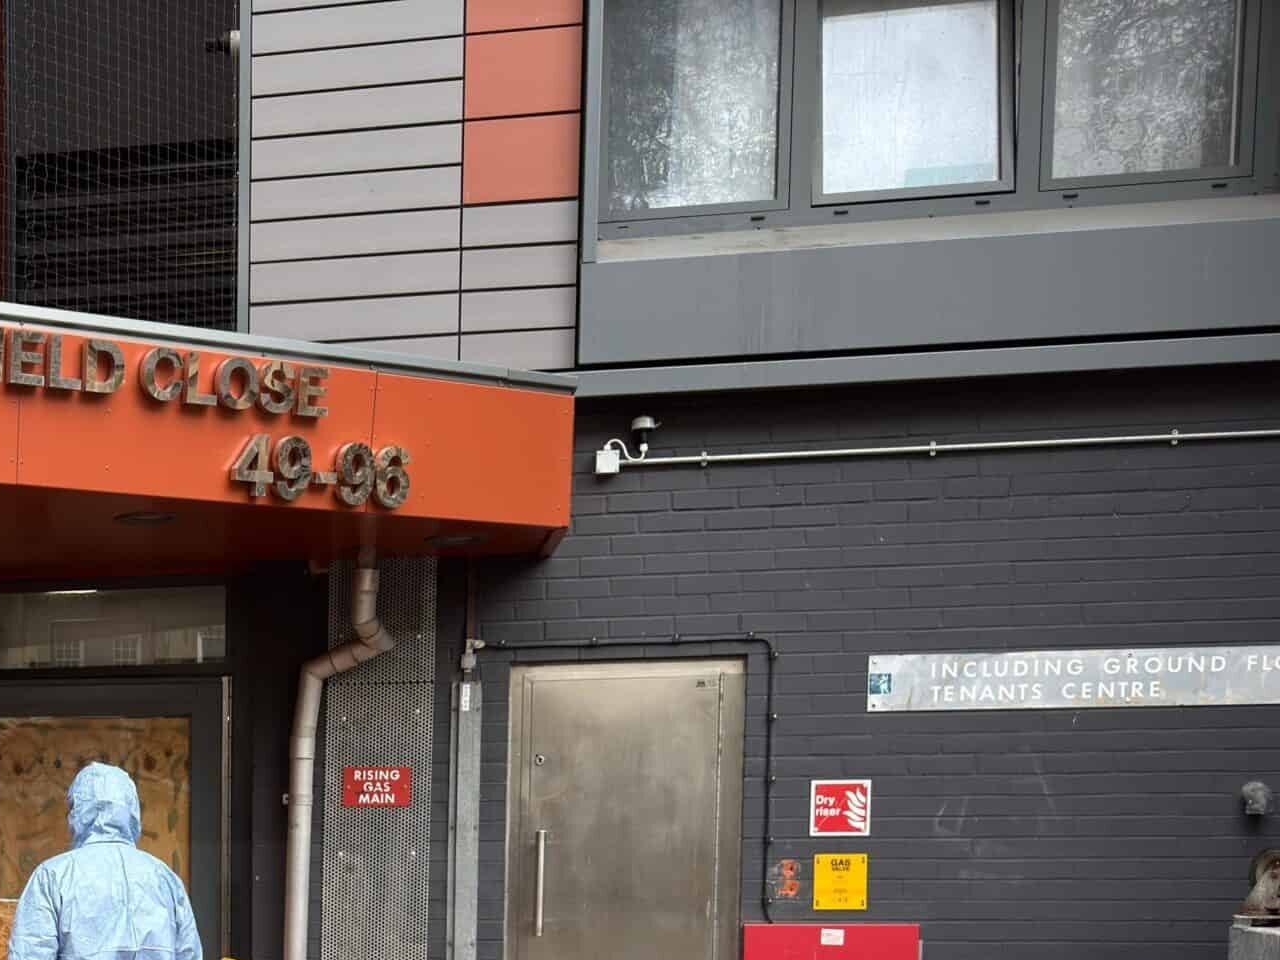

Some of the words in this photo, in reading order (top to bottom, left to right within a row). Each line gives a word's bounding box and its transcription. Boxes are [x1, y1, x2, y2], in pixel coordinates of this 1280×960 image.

[138, 346, 329, 418] CLOSE
[231, 433, 410, 509] 49-96
[930, 658, 1084, 679] INCLUDING
[1103, 655, 1227, 675] GROUND
[931, 685, 1042, 702] TENANTS
[1061, 681, 1161, 699] CENTRE
[353, 770, 400, 781] RISING
[363, 782, 391, 792] GAS
[358, 793, 395, 804] MAIN
[815, 795, 835, 807] Dry
[815, 807, 841, 817] riser
[831, 858, 850, 866] GAS
